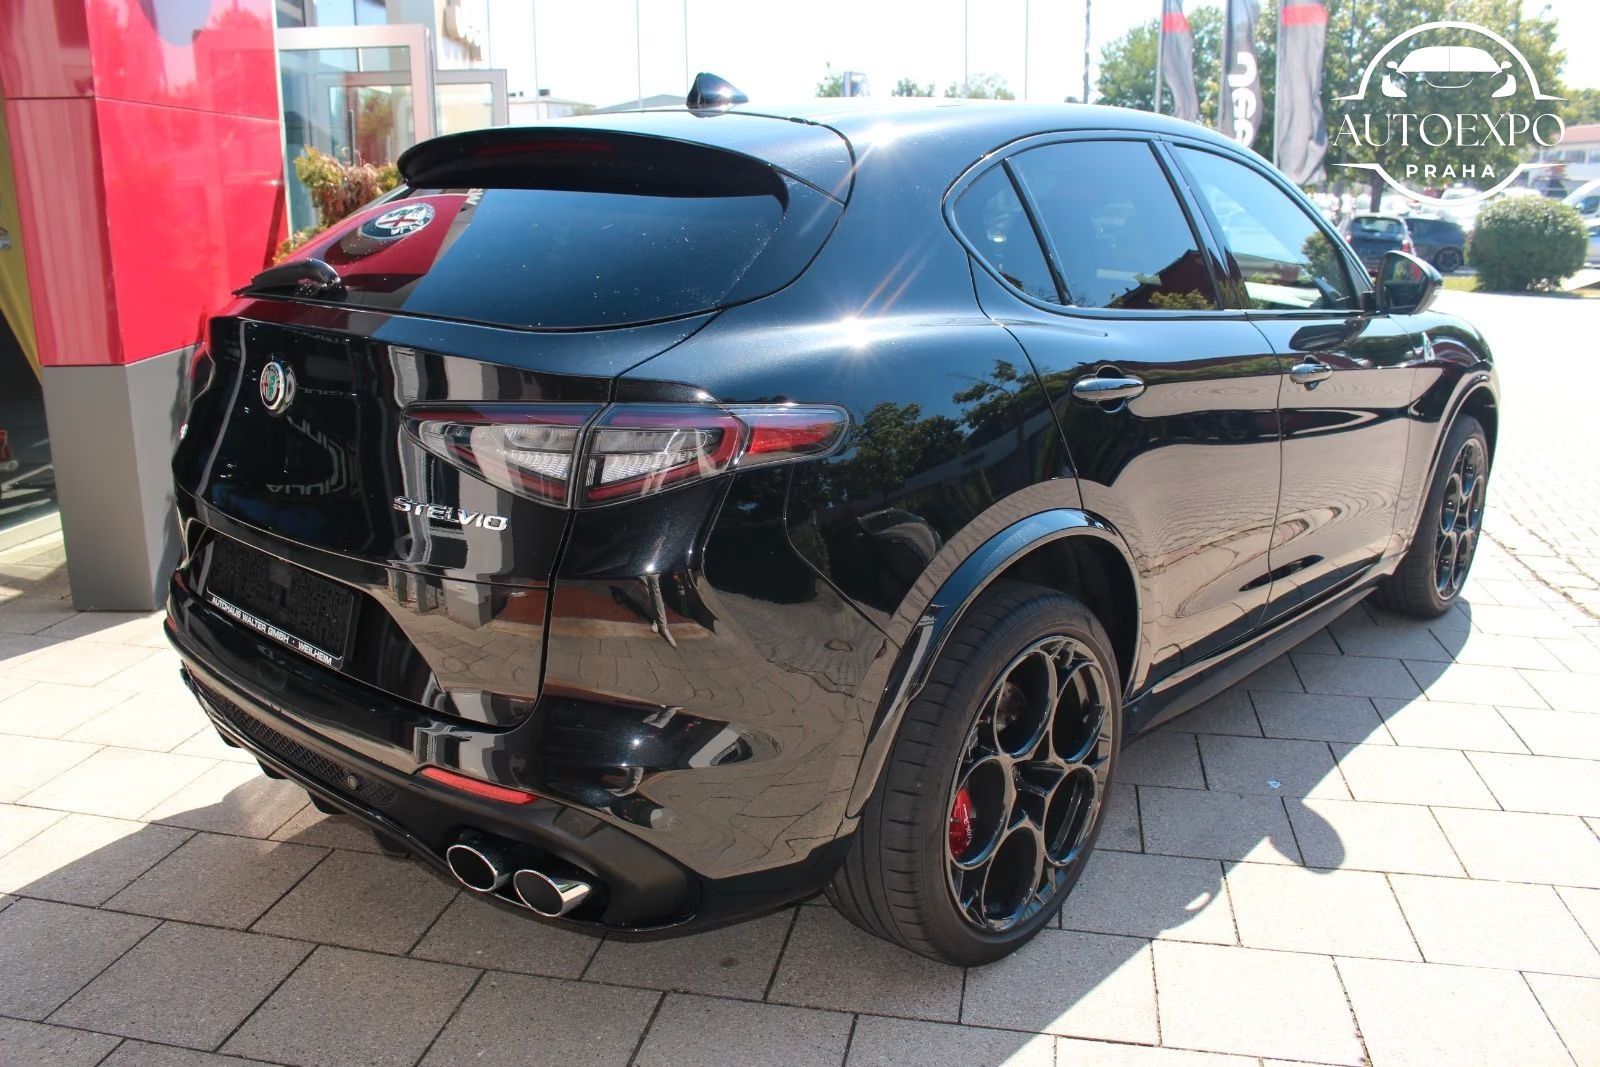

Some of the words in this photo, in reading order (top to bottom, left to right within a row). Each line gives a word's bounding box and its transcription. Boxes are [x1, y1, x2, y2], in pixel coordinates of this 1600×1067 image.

[392, 495, 509, 532] STELVIO
[211, 596, 242, 619] AUTOHAUS
[242, 612, 267, 634] WALTER
[267, 626, 290, 644] GMBH
[298, 640, 333, 666] WEILHEIM
